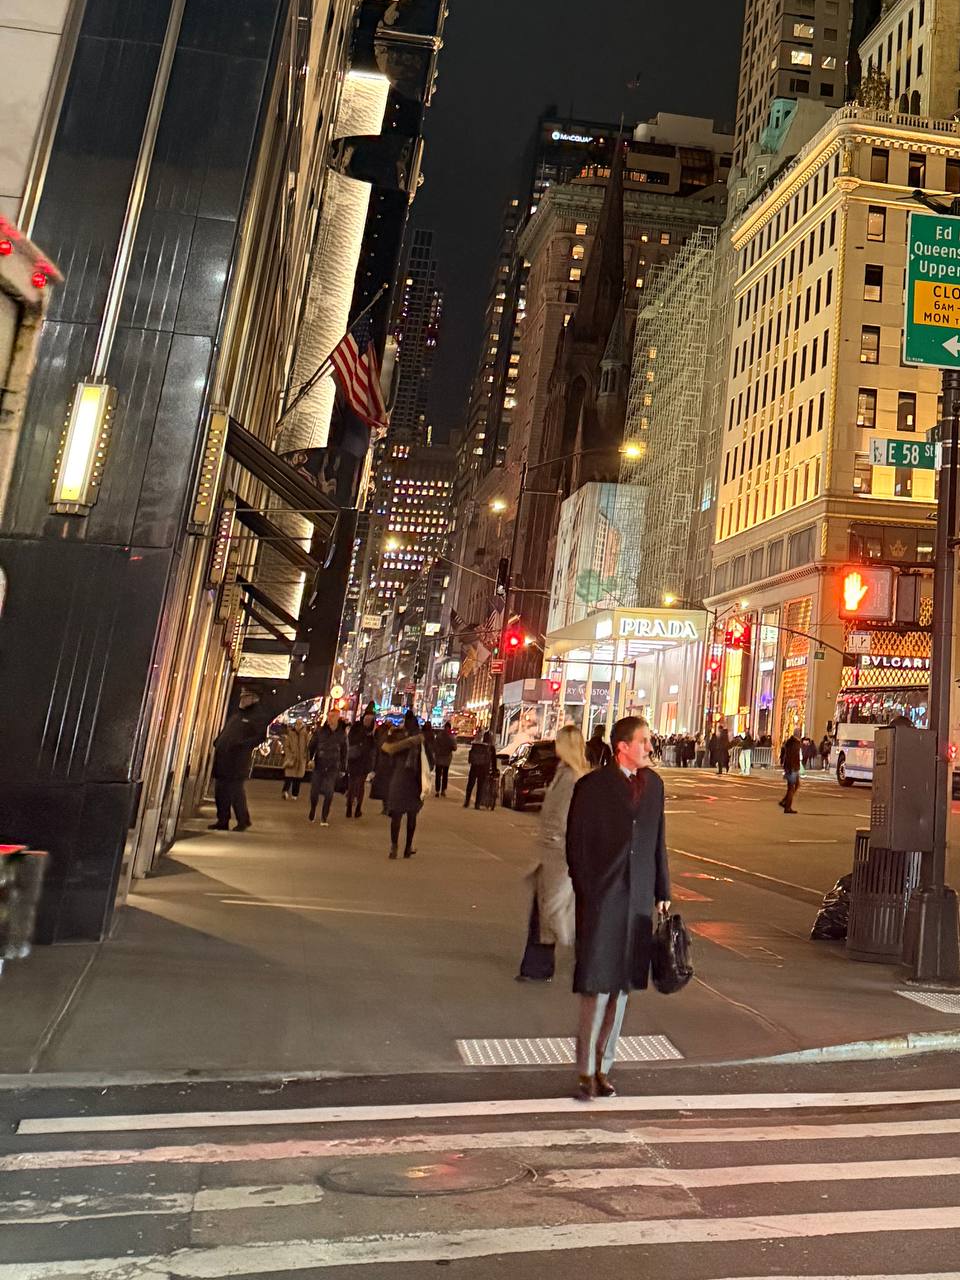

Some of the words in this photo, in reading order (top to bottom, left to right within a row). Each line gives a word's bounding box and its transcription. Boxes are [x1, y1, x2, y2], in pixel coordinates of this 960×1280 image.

[936, 226, 952, 240] Ed
[923, 311, 950, 324] MON
[888, 443, 897, 463] E
[902, 444, 919, 465] 58
[925, 444, 934, 457] St
[620, 616, 699, 639] PRADA
[861, 655, 930, 669] BVLGARI
